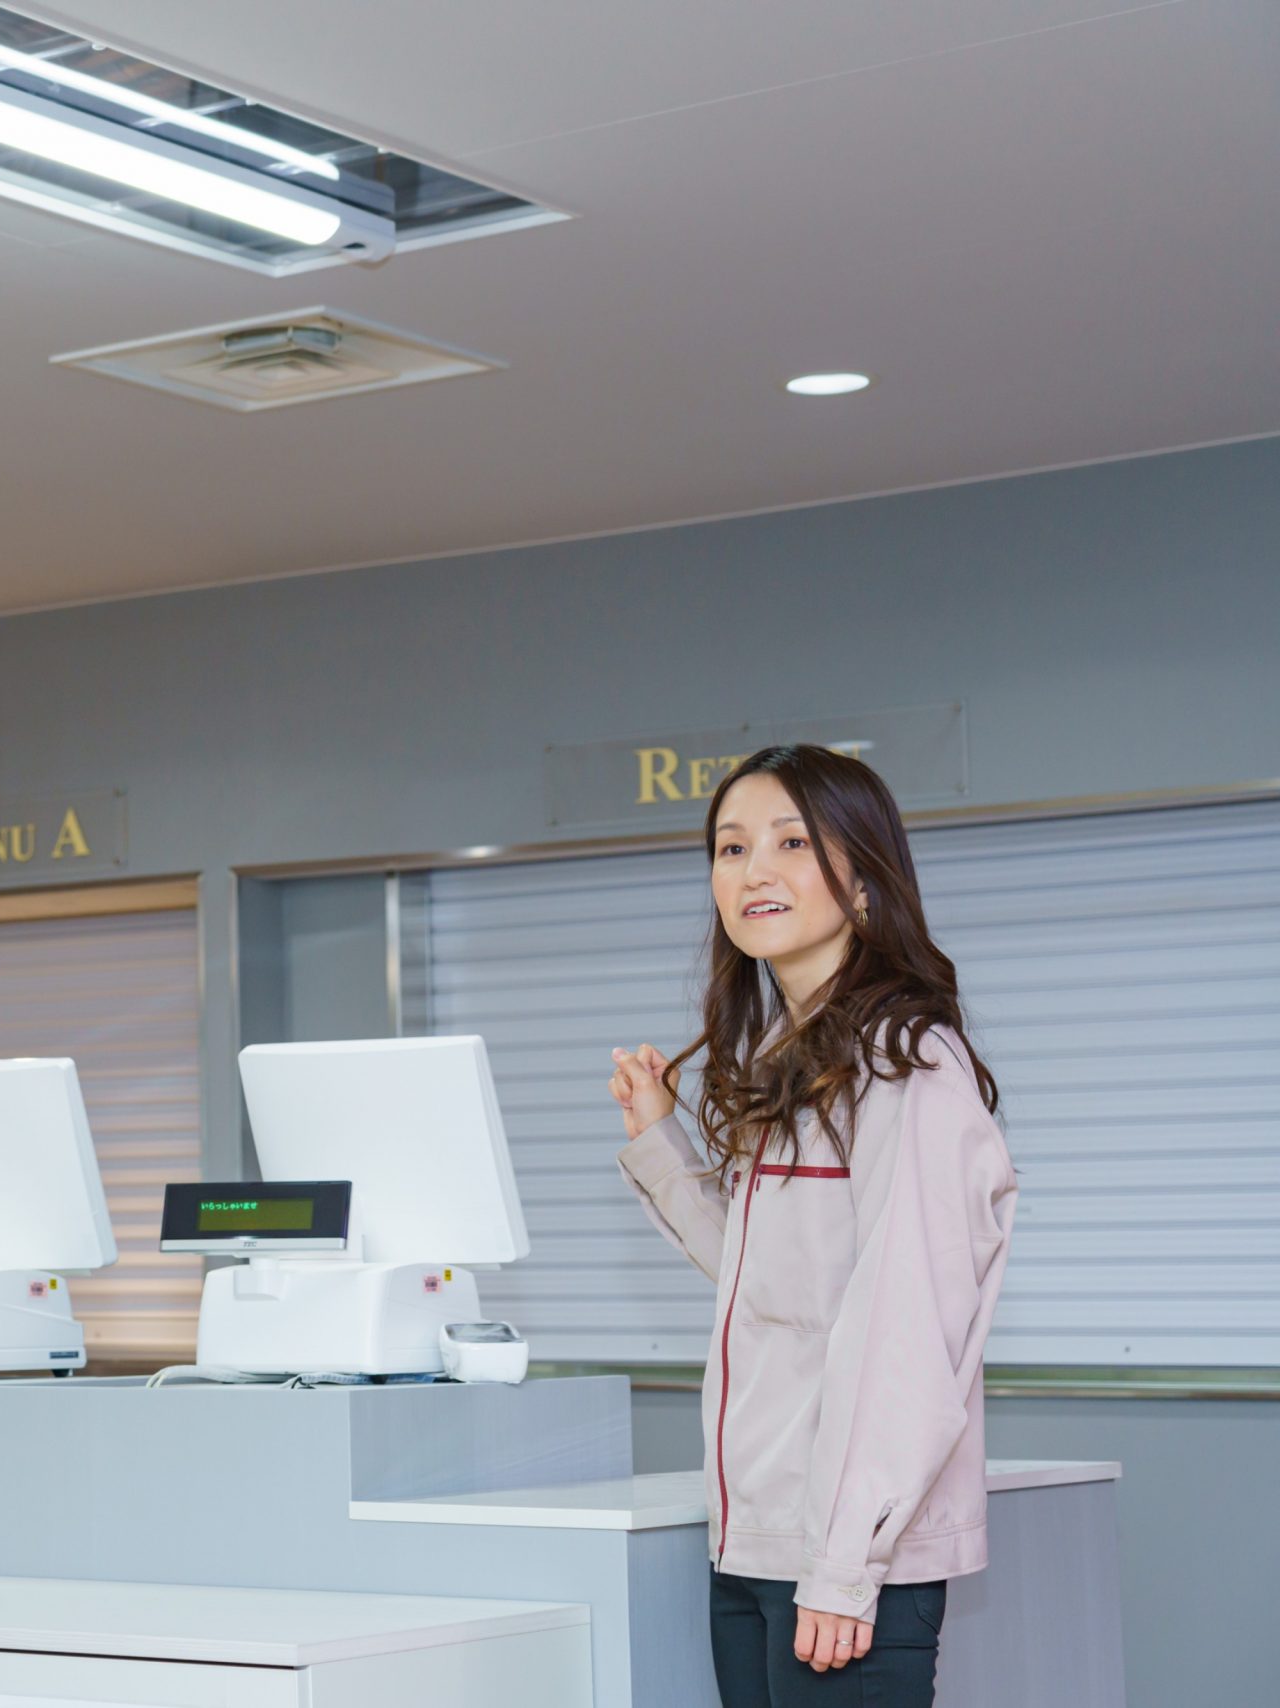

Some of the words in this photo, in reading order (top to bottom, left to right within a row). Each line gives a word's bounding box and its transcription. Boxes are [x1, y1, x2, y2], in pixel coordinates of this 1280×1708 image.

[52, 808, 91, 860] A
[200, 1201, 258, 1211] いらっしゃいませ
